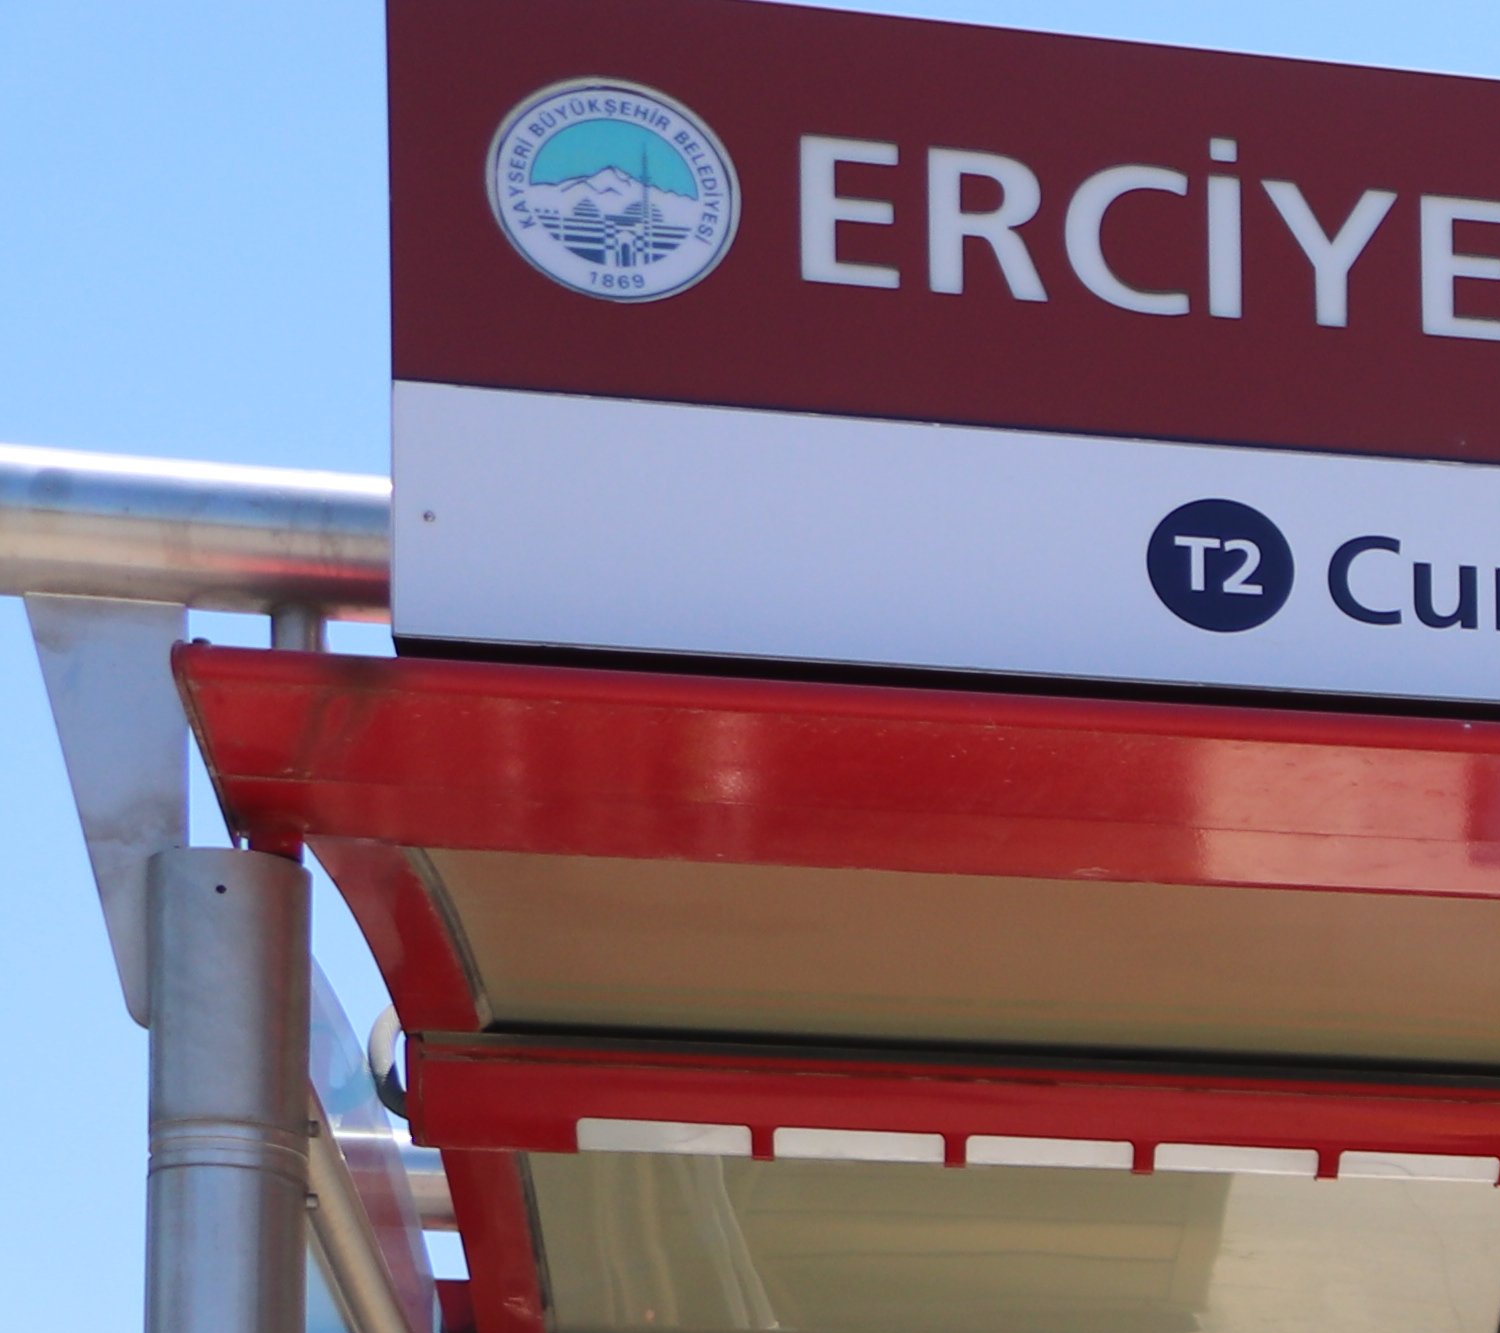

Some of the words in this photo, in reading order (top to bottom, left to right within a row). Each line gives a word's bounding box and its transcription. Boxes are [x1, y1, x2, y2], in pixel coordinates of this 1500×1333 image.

[508, 136, 536, 230] KAYSERİ
[529, 98, 671, 137] BÜYÜKŞEHİR
[673, 131, 724, 246] BELEDİYESİ
[589, 271, 646, 289] 1869
[1172, 537, 1266, 598] T2
